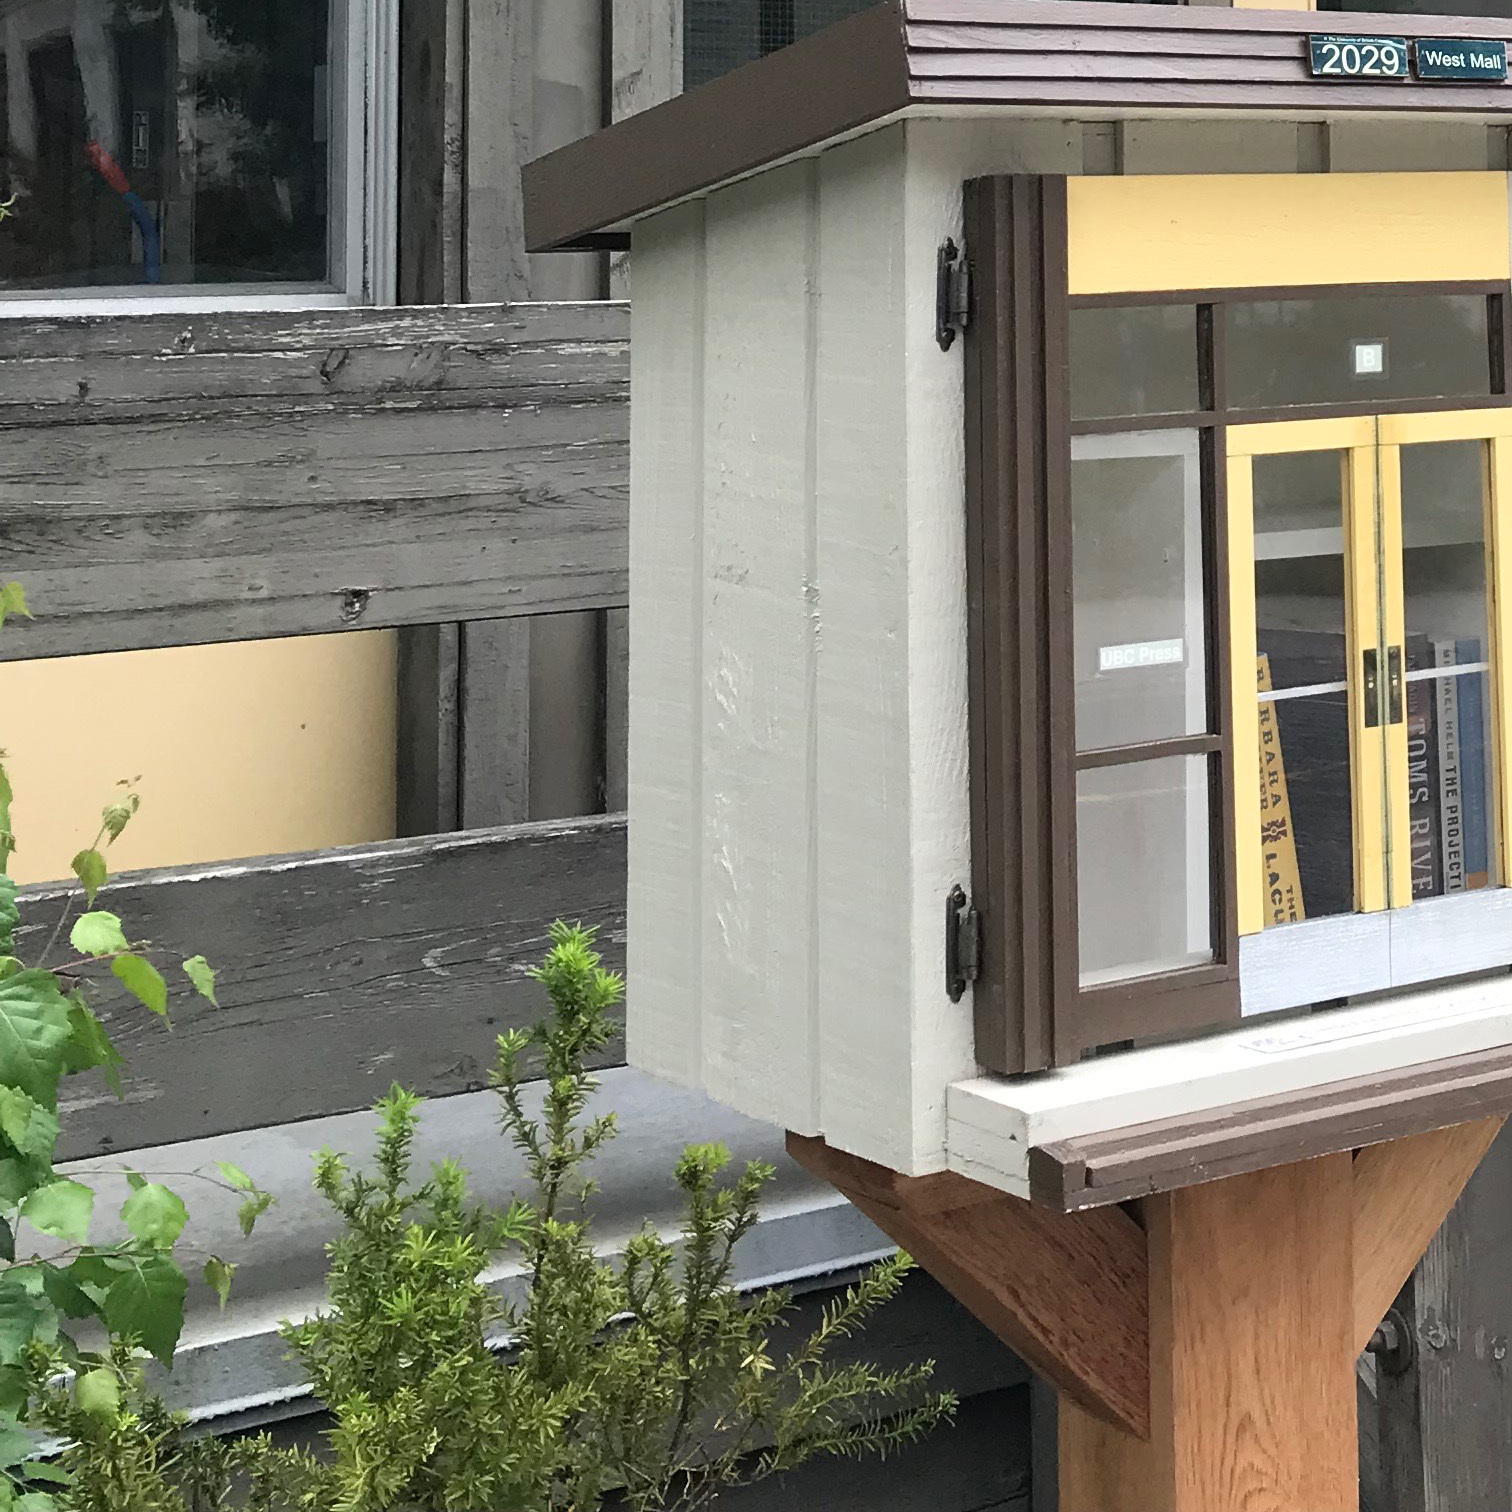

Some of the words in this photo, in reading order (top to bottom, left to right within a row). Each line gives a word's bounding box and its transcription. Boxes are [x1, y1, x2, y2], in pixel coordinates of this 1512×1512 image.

[1321, 44, 1400, 75] 2029
[1425, 50, 1466, 68] West
[1470, 52, 1502, 69] Mall
[1362, 348, 1375, 366] B
[1101, 648, 1135, 667] UBC
[1139, 647, 1181, 663] Press
[1443, 648, 1453, 715] MIHAEL
[1408, 717, 1429, 805] TOMS
[1445, 764, 1459, 799] THE
[1286, 885, 1298, 922] THE
